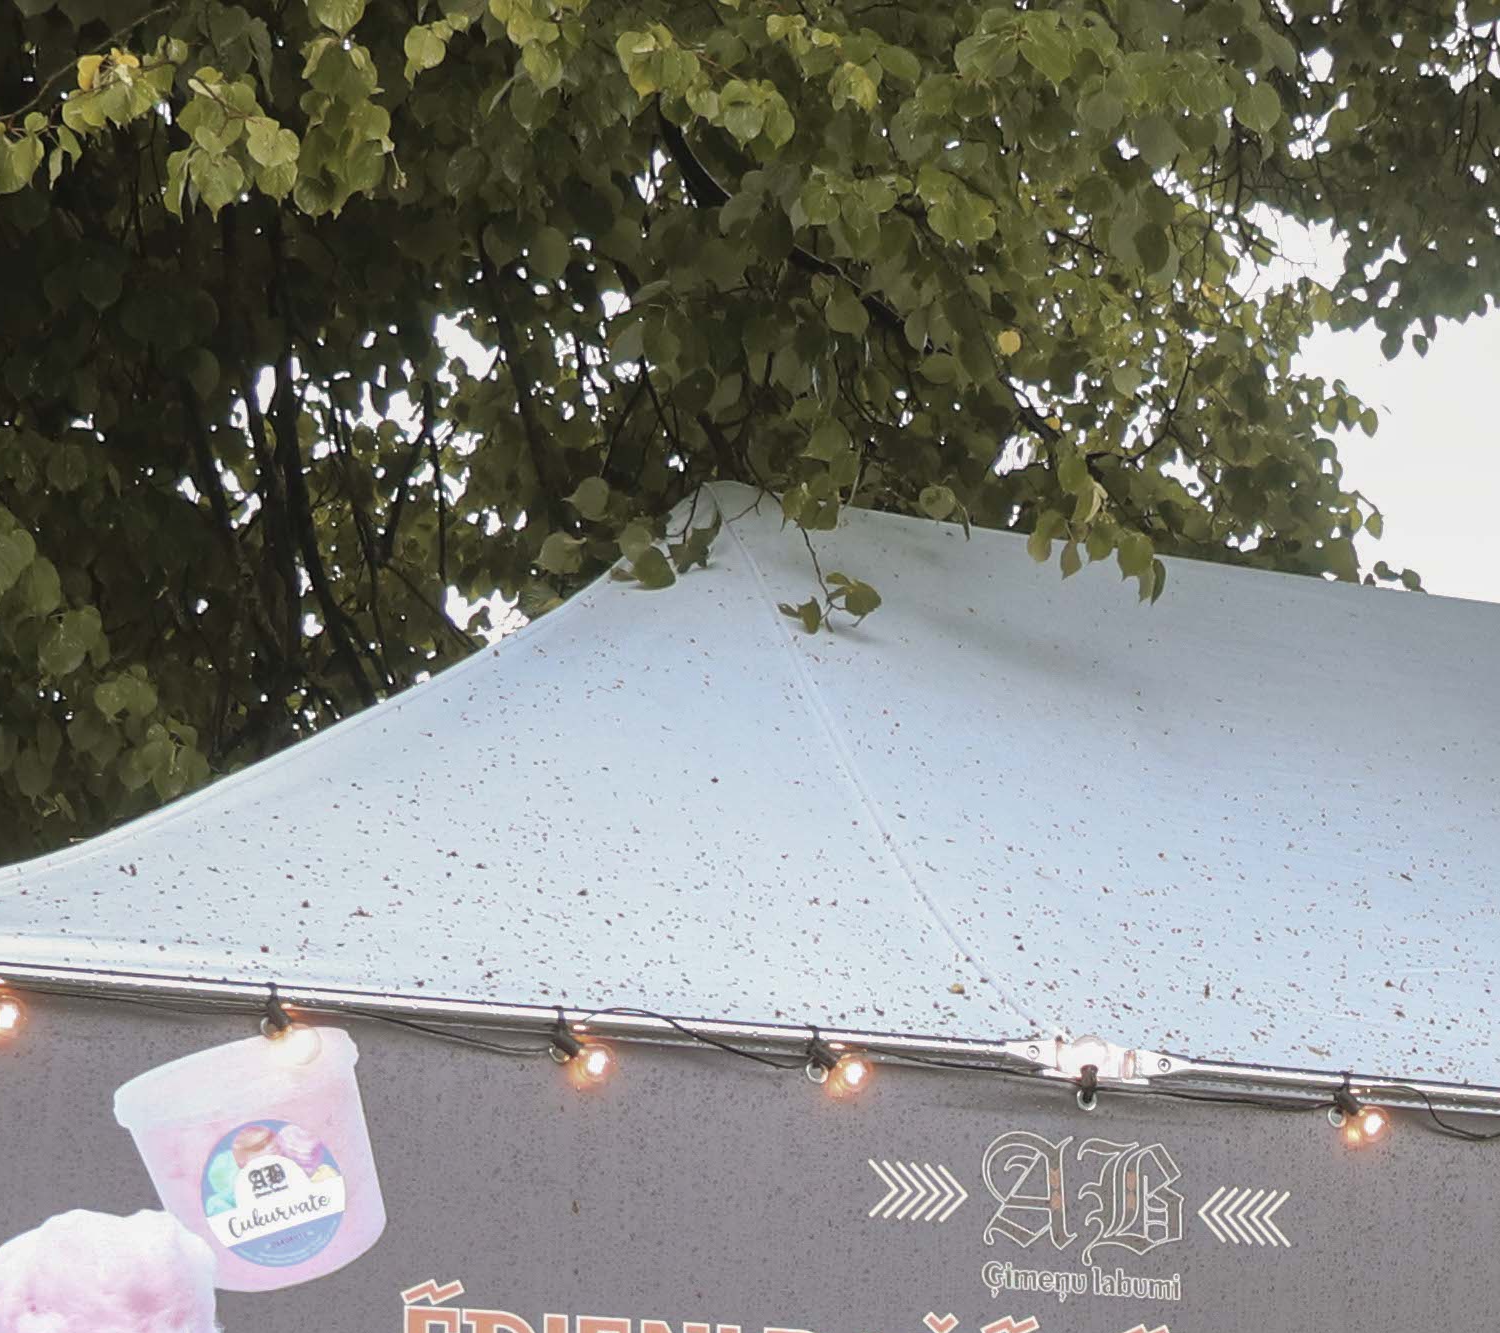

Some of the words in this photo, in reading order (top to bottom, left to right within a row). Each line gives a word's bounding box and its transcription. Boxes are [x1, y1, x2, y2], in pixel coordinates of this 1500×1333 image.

[228, 1193, 331, 1239] Cukurvate
[981, 1261, 1087, 1302] Ģimeņu
[1091, 1266, 1181, 1300] labumi
